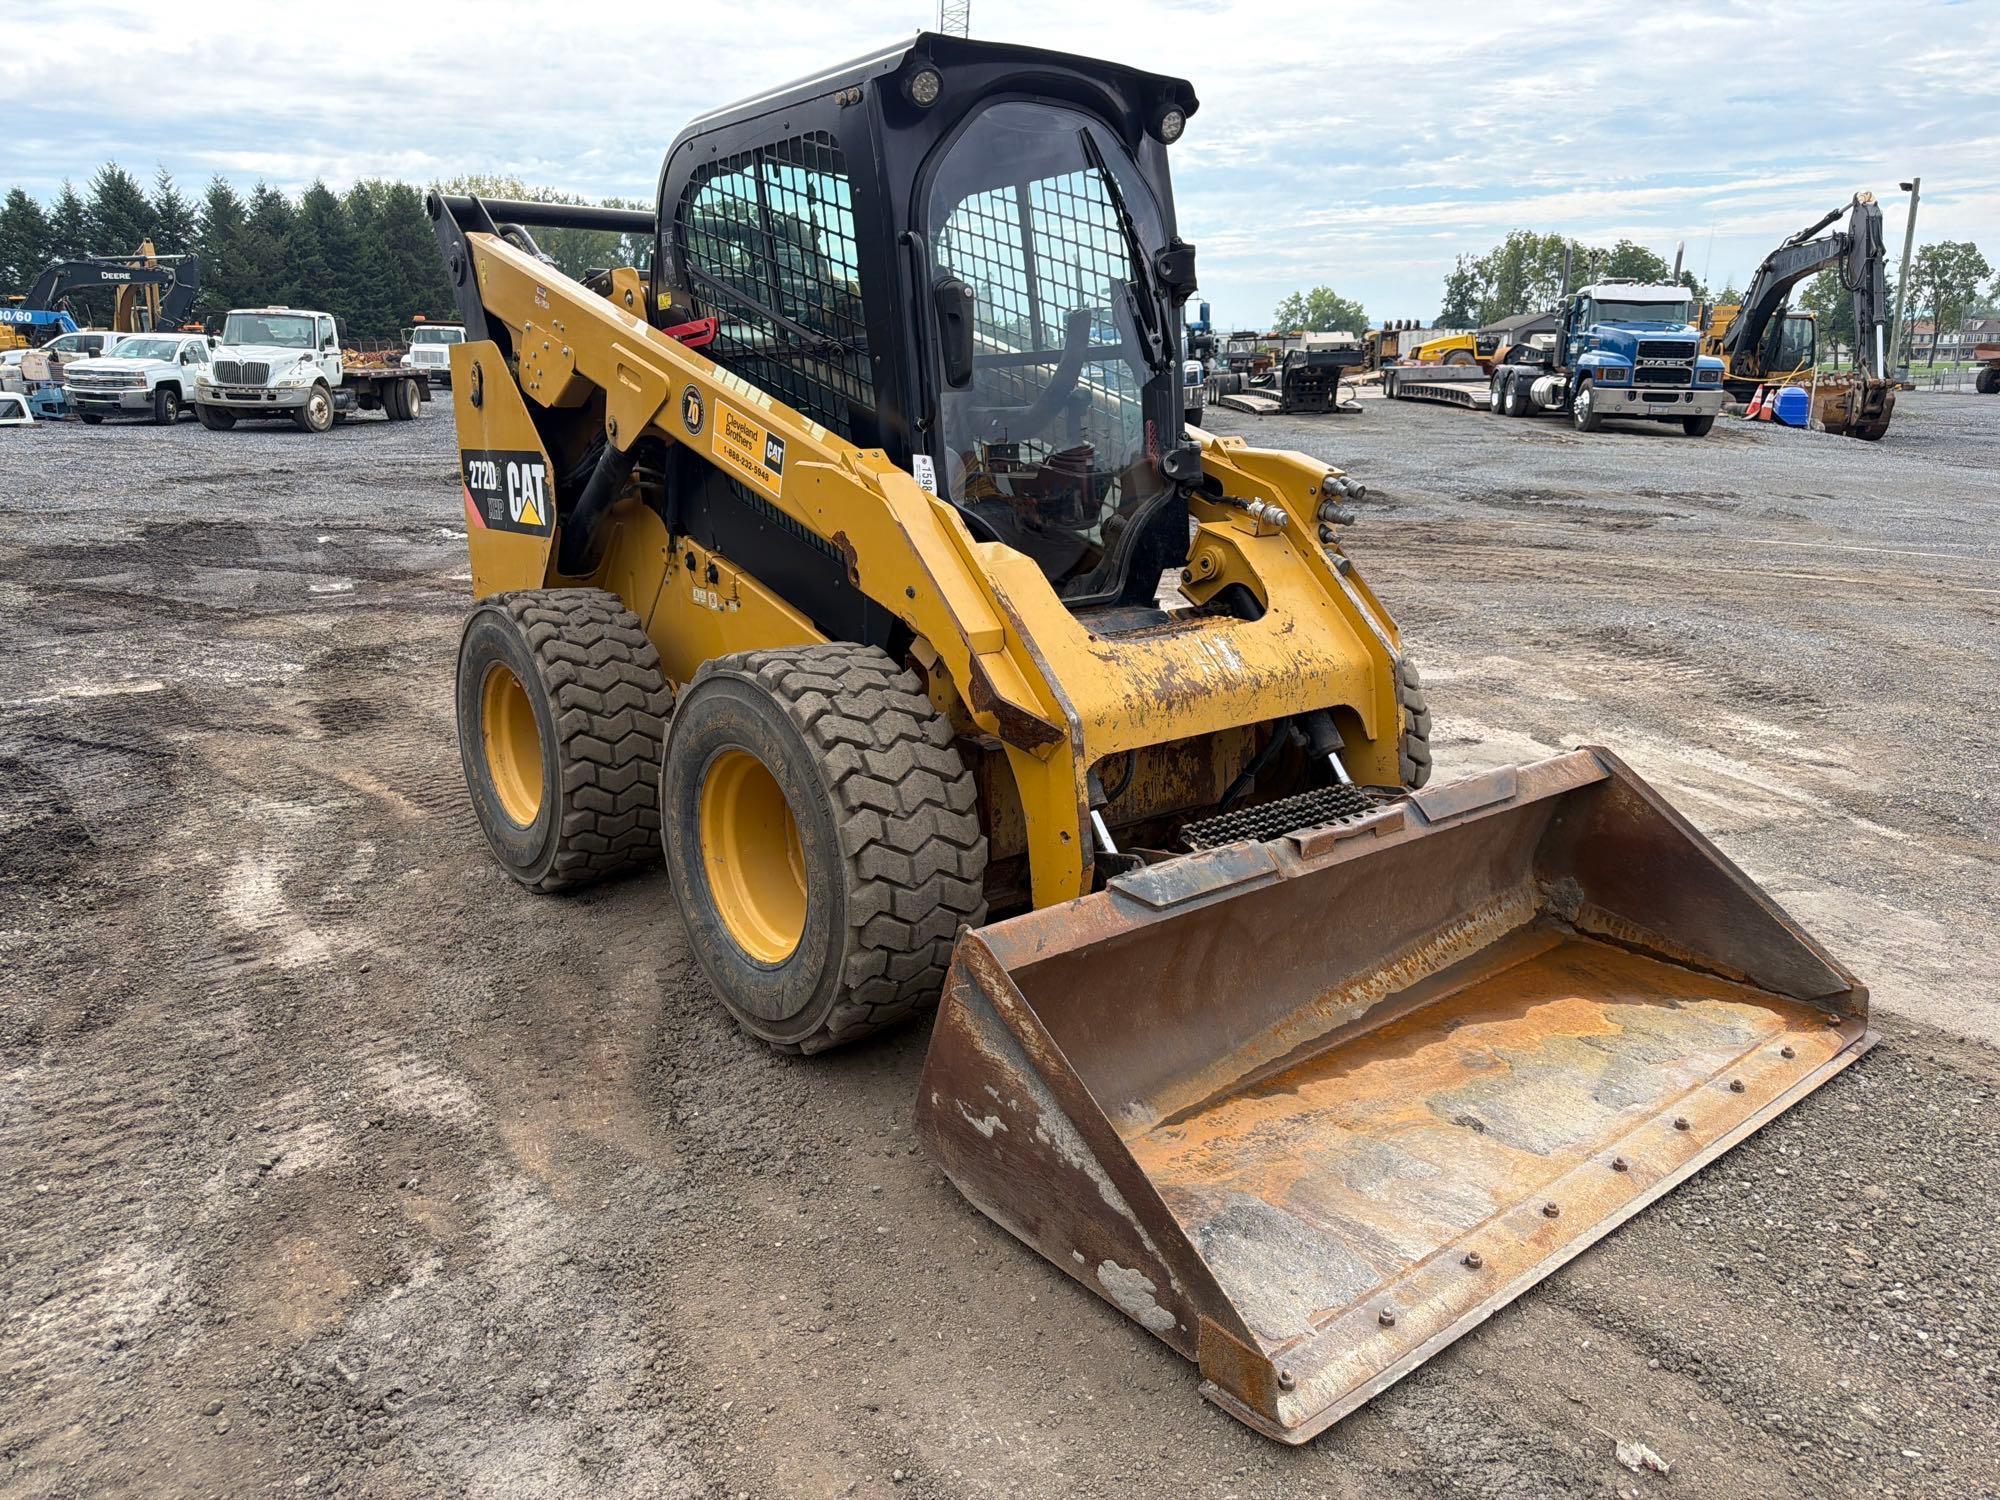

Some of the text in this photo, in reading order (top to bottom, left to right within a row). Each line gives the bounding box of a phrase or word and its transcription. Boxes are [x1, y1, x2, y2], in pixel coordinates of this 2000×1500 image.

[101, 271, 131, 280] DEERE
[725, 424, 753, 451] Brothers
[726, 413, 758, 441] Cleveland
[723, 445, 770, 482] 1-888-232-5948
[766, 440, 783, 464] CAT
[921, 466, 933, 491] 1598
[507, 461, 546, 526] CAT
